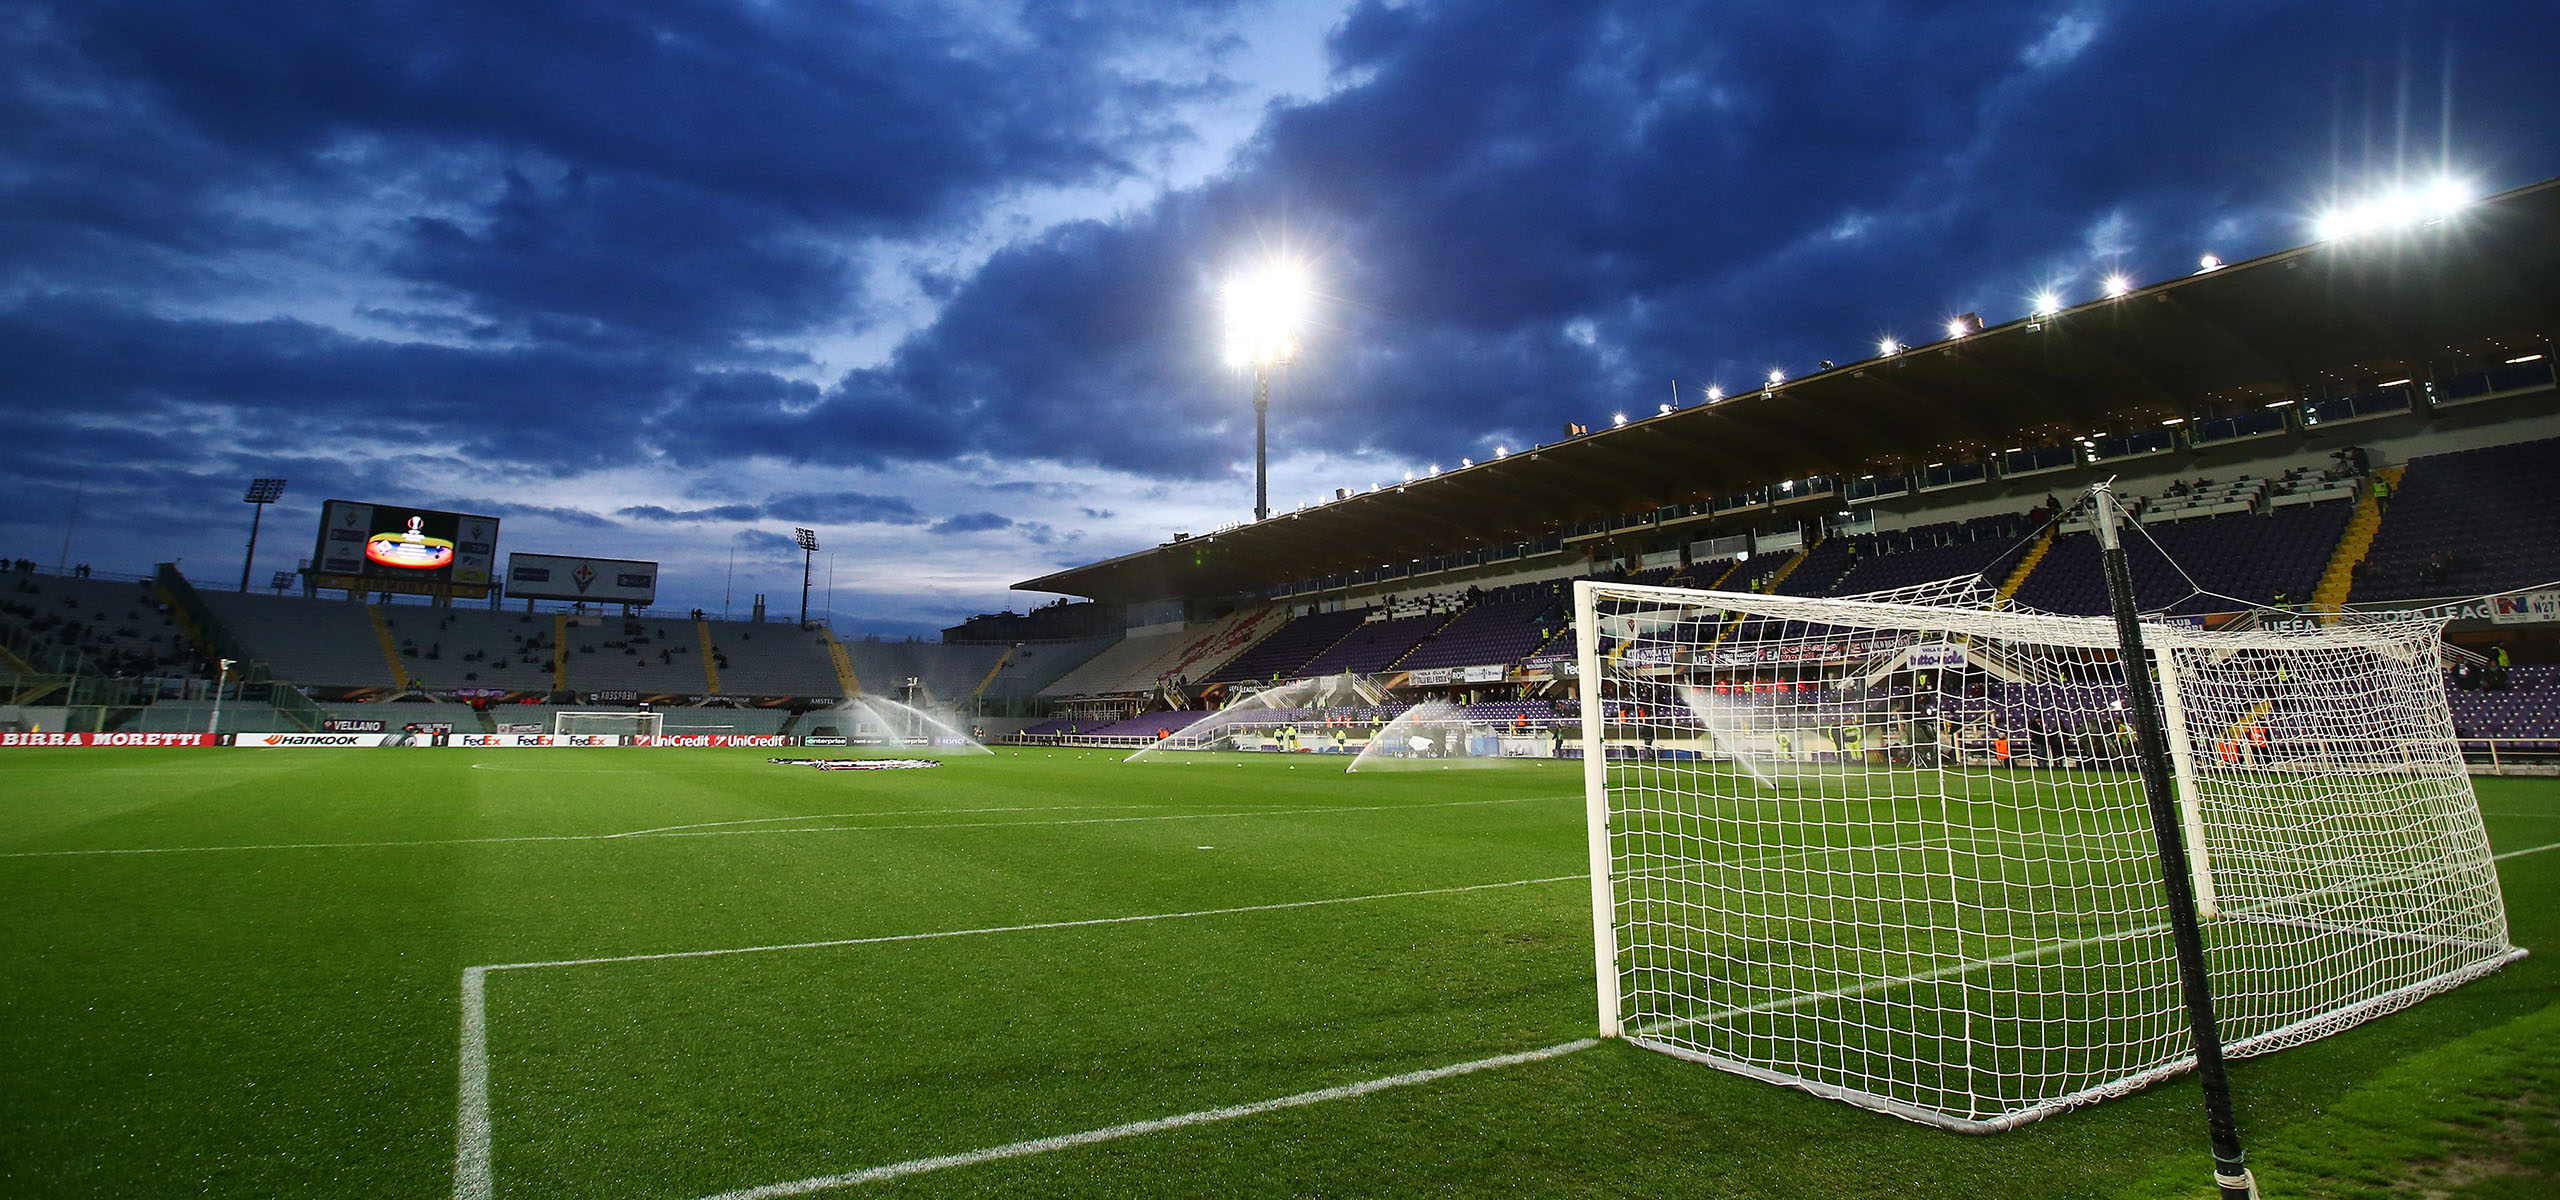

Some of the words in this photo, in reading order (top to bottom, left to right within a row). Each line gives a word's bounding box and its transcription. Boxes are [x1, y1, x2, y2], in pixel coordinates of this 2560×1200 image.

[2263, 619, 2317, 633] UEFA
[333, 720, 381, 732] VELLANO
[1, 733, 83, 747] BIRRA
[92, 733, 202, 747] MORETTI
[463, 735, 501, 746] FedEx
[517, 735, 553, 746] FedEx
[569, 735, 605, 746] FedEx
[650, 735, 710, 747] UniCredit
[727, 735, 786, 747] UniCredit
[805, 737, 847, 746] enterprise
